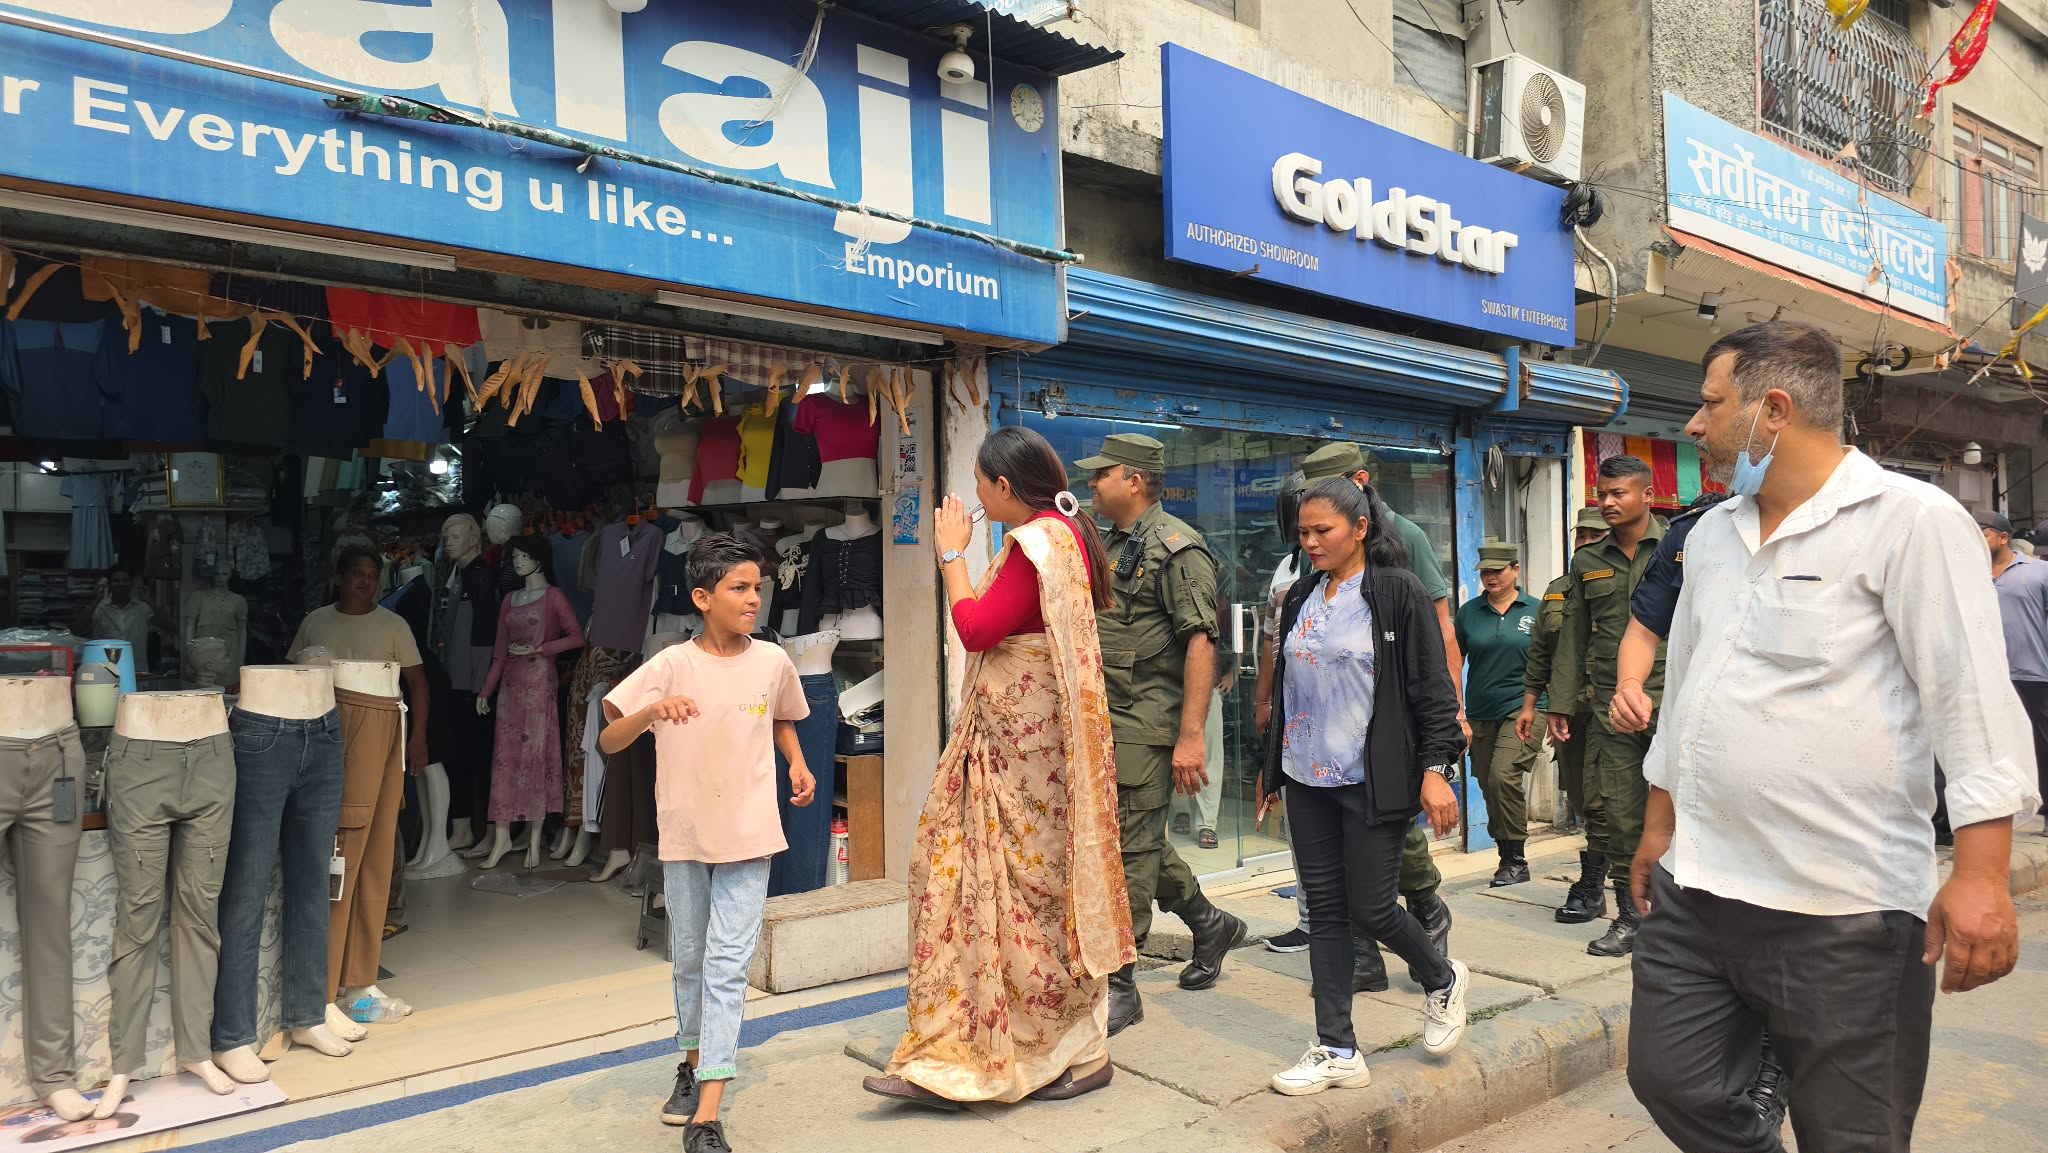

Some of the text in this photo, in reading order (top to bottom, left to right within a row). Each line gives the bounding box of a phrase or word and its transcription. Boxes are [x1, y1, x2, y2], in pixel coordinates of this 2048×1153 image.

[73, 76, 503, 212] Everything
[529, 177, 564, 214] u
[1272, 152, 1518, 273] GoldStar
[844, 241, 999, 300] Emporium
[1186, 222, 1319, 272] AUTHORIZED SHOWROOM
[1481, 299, 1568, 332] SWASTIK ENTERPRISE
